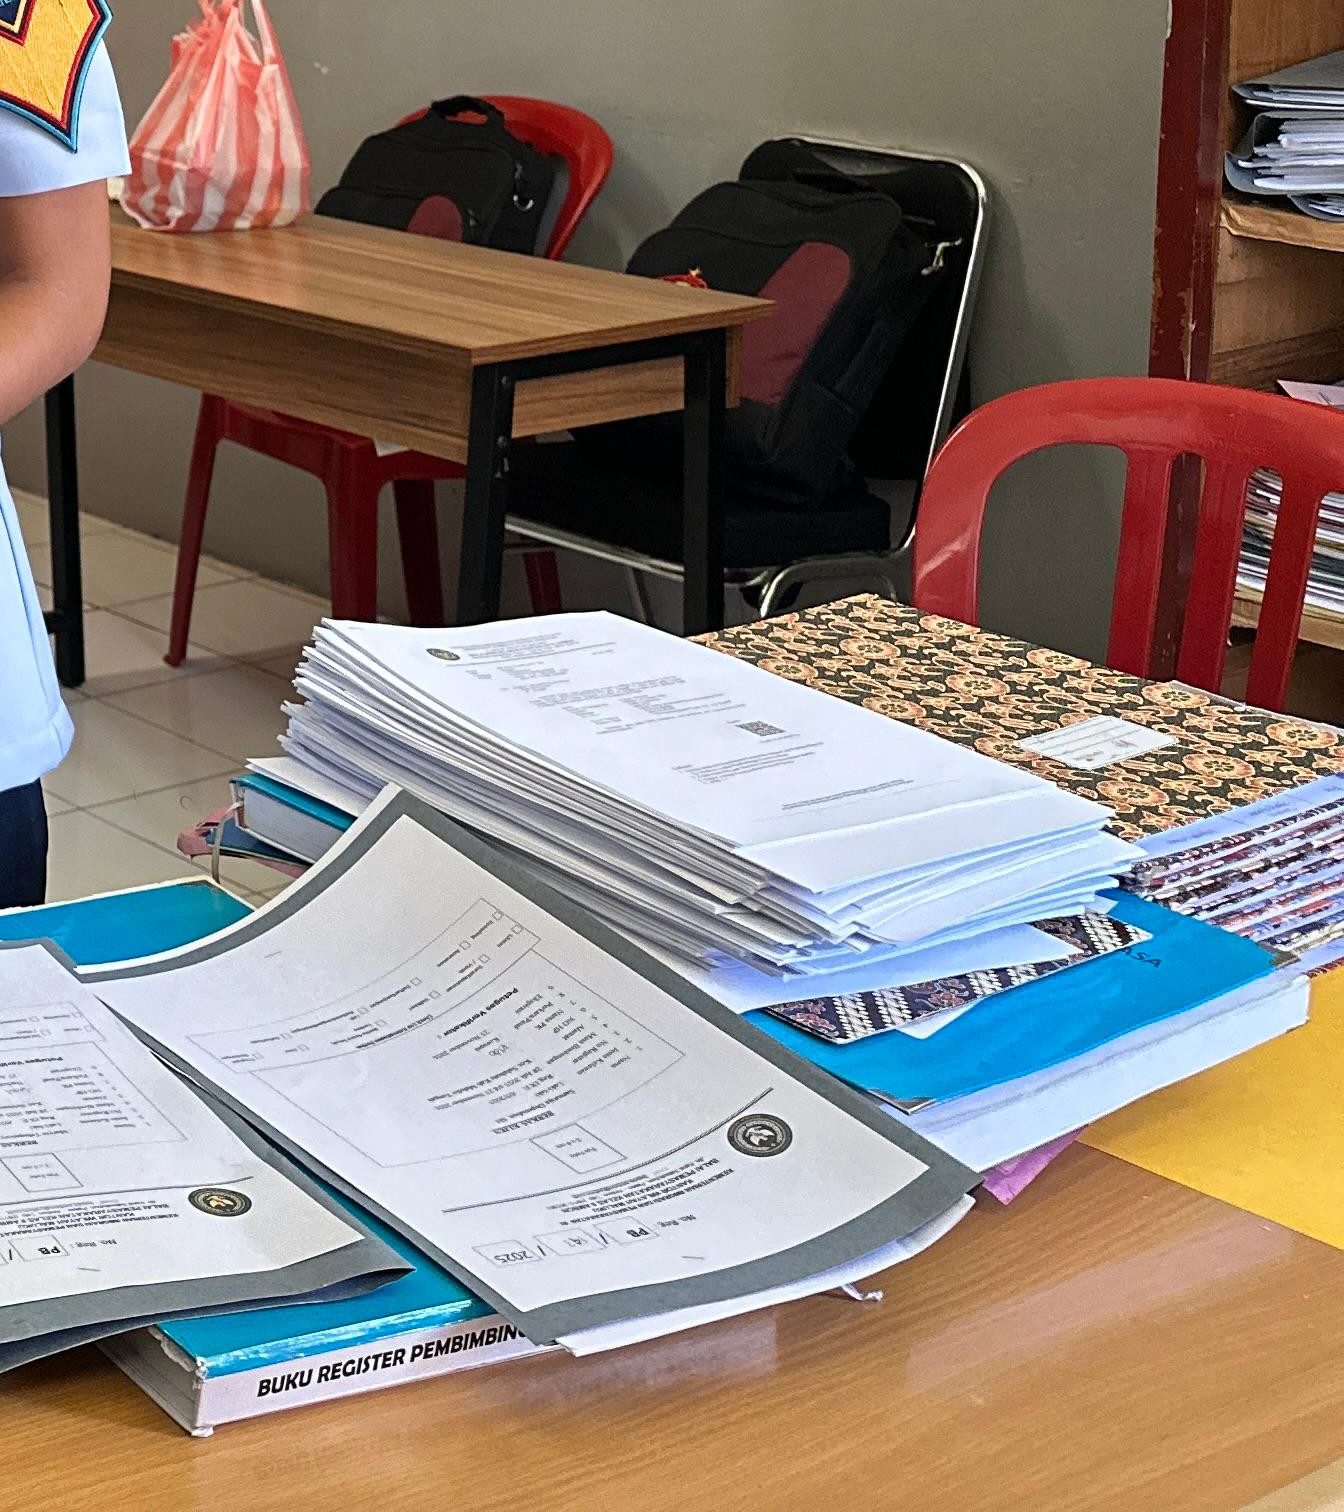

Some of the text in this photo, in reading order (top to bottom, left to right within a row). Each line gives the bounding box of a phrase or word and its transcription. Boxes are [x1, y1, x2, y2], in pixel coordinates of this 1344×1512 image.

[626, 1227, 649, 1237] PB
[37, 1245, 60, 1255] PB
[493, 1250, 532, 1263] 2025
[257, 1368, 313, 1398] BUKU
[317, 1347, 407, 1384] REGISTER
